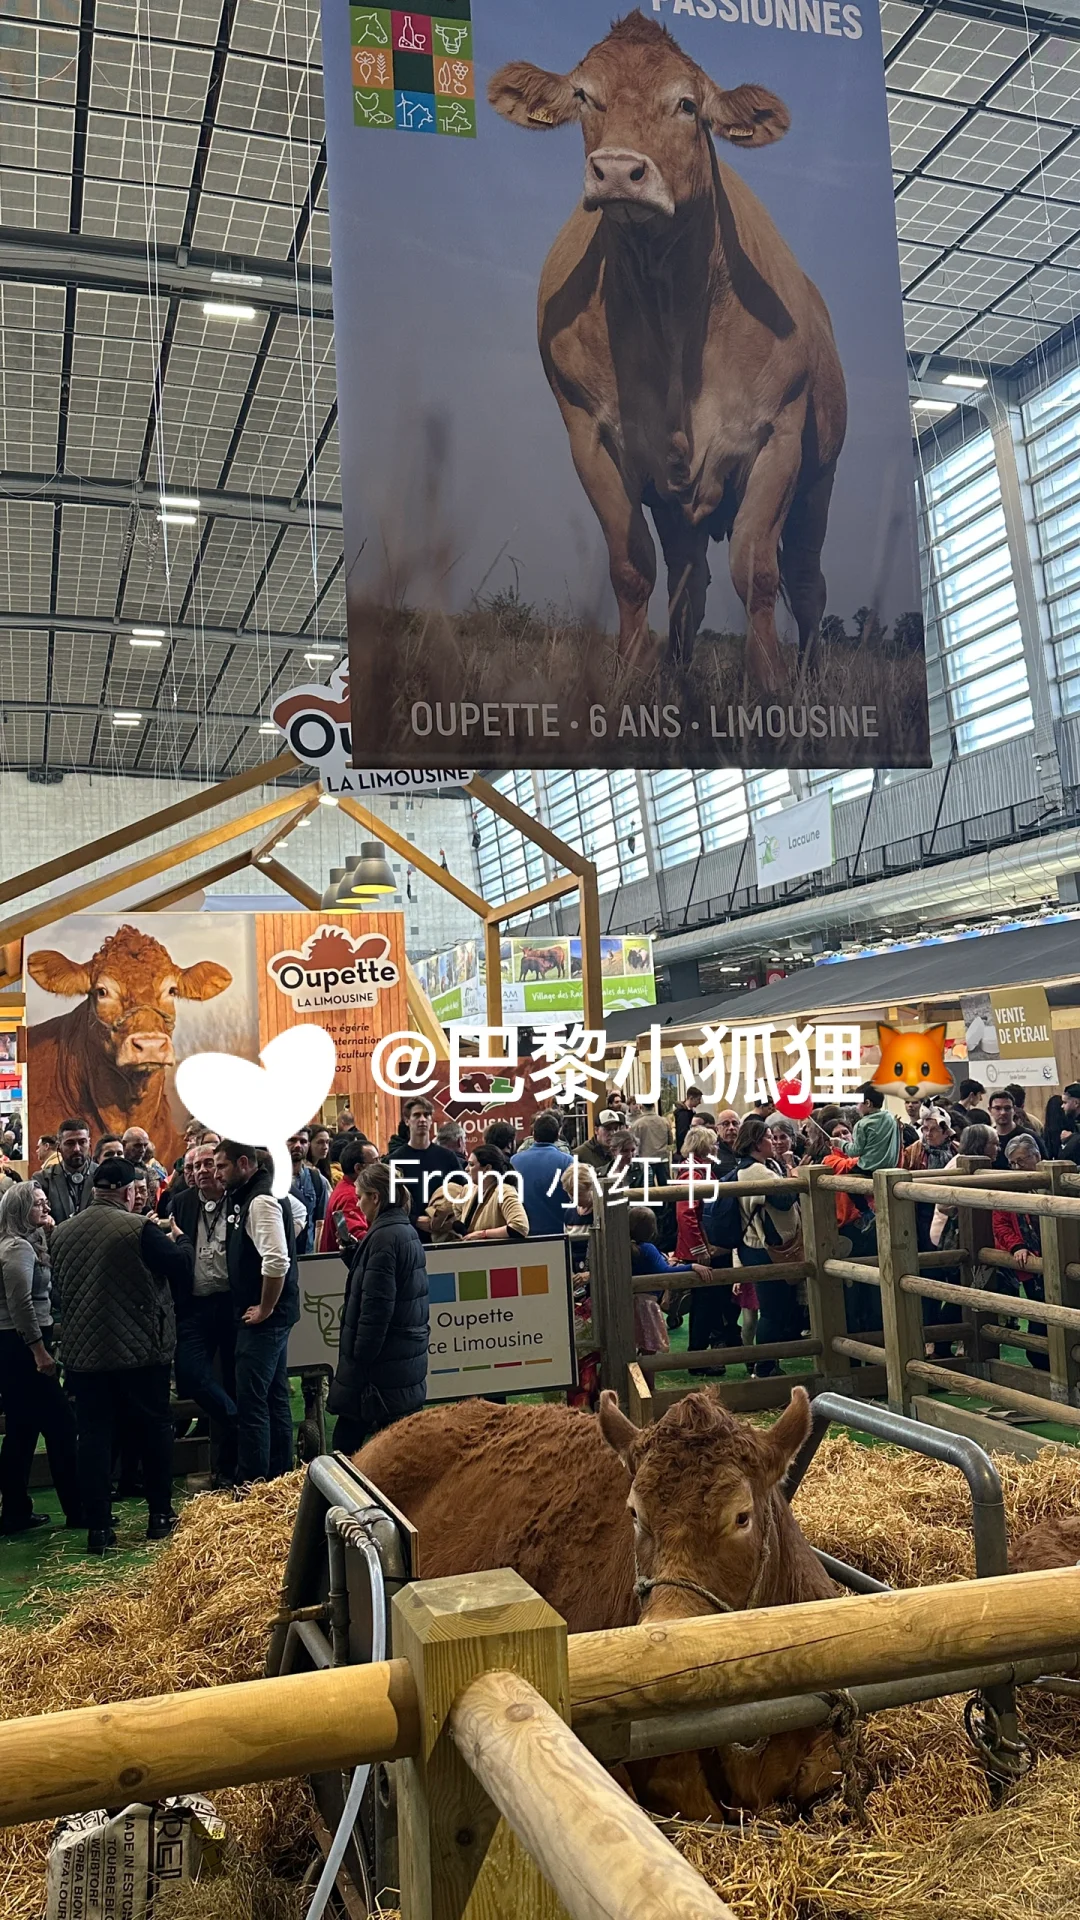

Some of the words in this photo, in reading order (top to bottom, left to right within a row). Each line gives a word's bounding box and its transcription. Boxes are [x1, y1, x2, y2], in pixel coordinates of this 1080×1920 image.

[411, 700, 560, 737] OUPETTE
[590, 702, 607, 738] 6
[617, 704, 681, 738] ANS
[710, 705, 879, 738] LIMOUSINE
[327, 776, 354, 792] LA
[358, 768, 469, 789] LIMOUSINE
[788, 829, 820, 849] Lacaune
[280, 960, 396, 993] Oupette
[297, 997, 311, 1008] LA
[314, 992, 374, 1006] LIMOUSINE
[532, 992, 556, 1002] Village
[557, 991, 568, 999] des
[617, 987, 625, 995] de
[627, 985, 648, 996] Massif
[995, 1006, 1026, 1024] VENTE
[340, 1023, 370, 1034] égérie
[999, 1028, 1012, 1044] DE
[1014, 1023, 1050, 1043] PÉRAIL
[335, 1065, 352, 1073] 025
[437, 1308, 514, 1330] Oupette
[428, 1340, 447, 1354] ce
[454, 1331, 543, 1353] Limousine
[106, 1839, 117, 1894] TOURBE
[124, 1855, 134, 1868] IN
